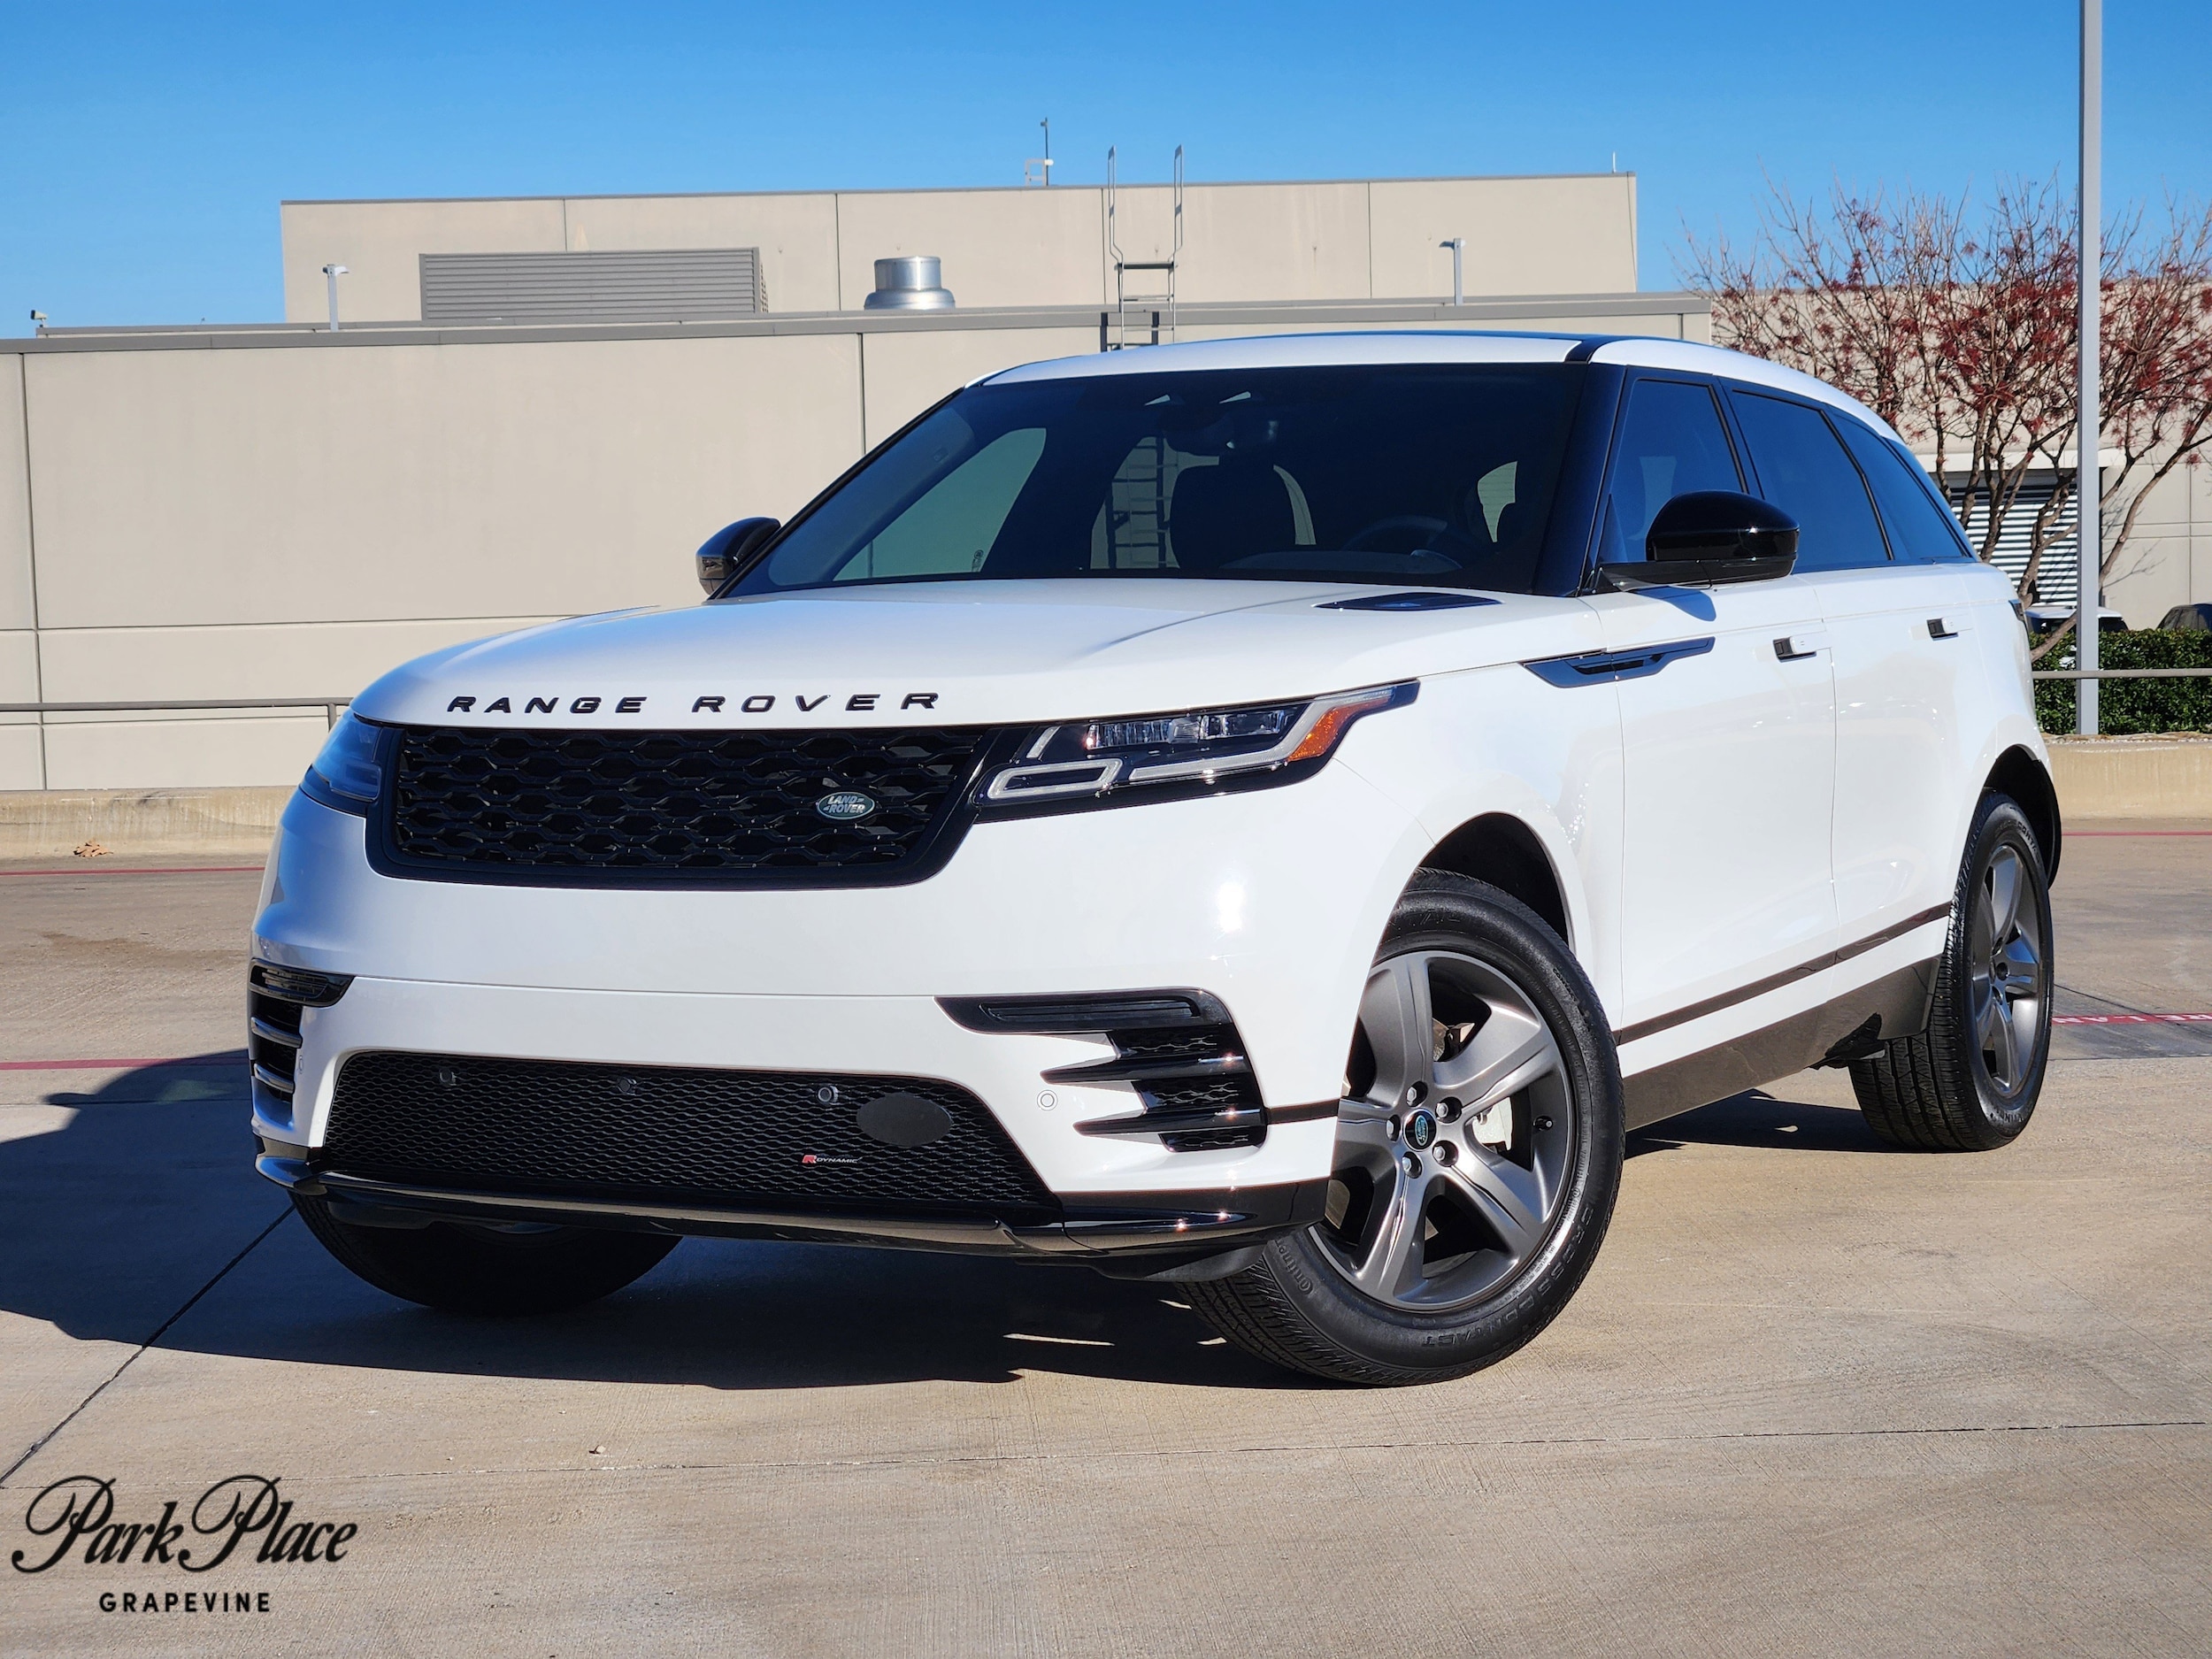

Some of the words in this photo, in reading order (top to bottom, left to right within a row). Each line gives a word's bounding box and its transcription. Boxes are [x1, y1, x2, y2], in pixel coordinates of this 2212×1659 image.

[447, 696, 647, 713] RANGE
[692, 693, 939, 712] ROVER
[828, 804, 865, 813] ROVER
